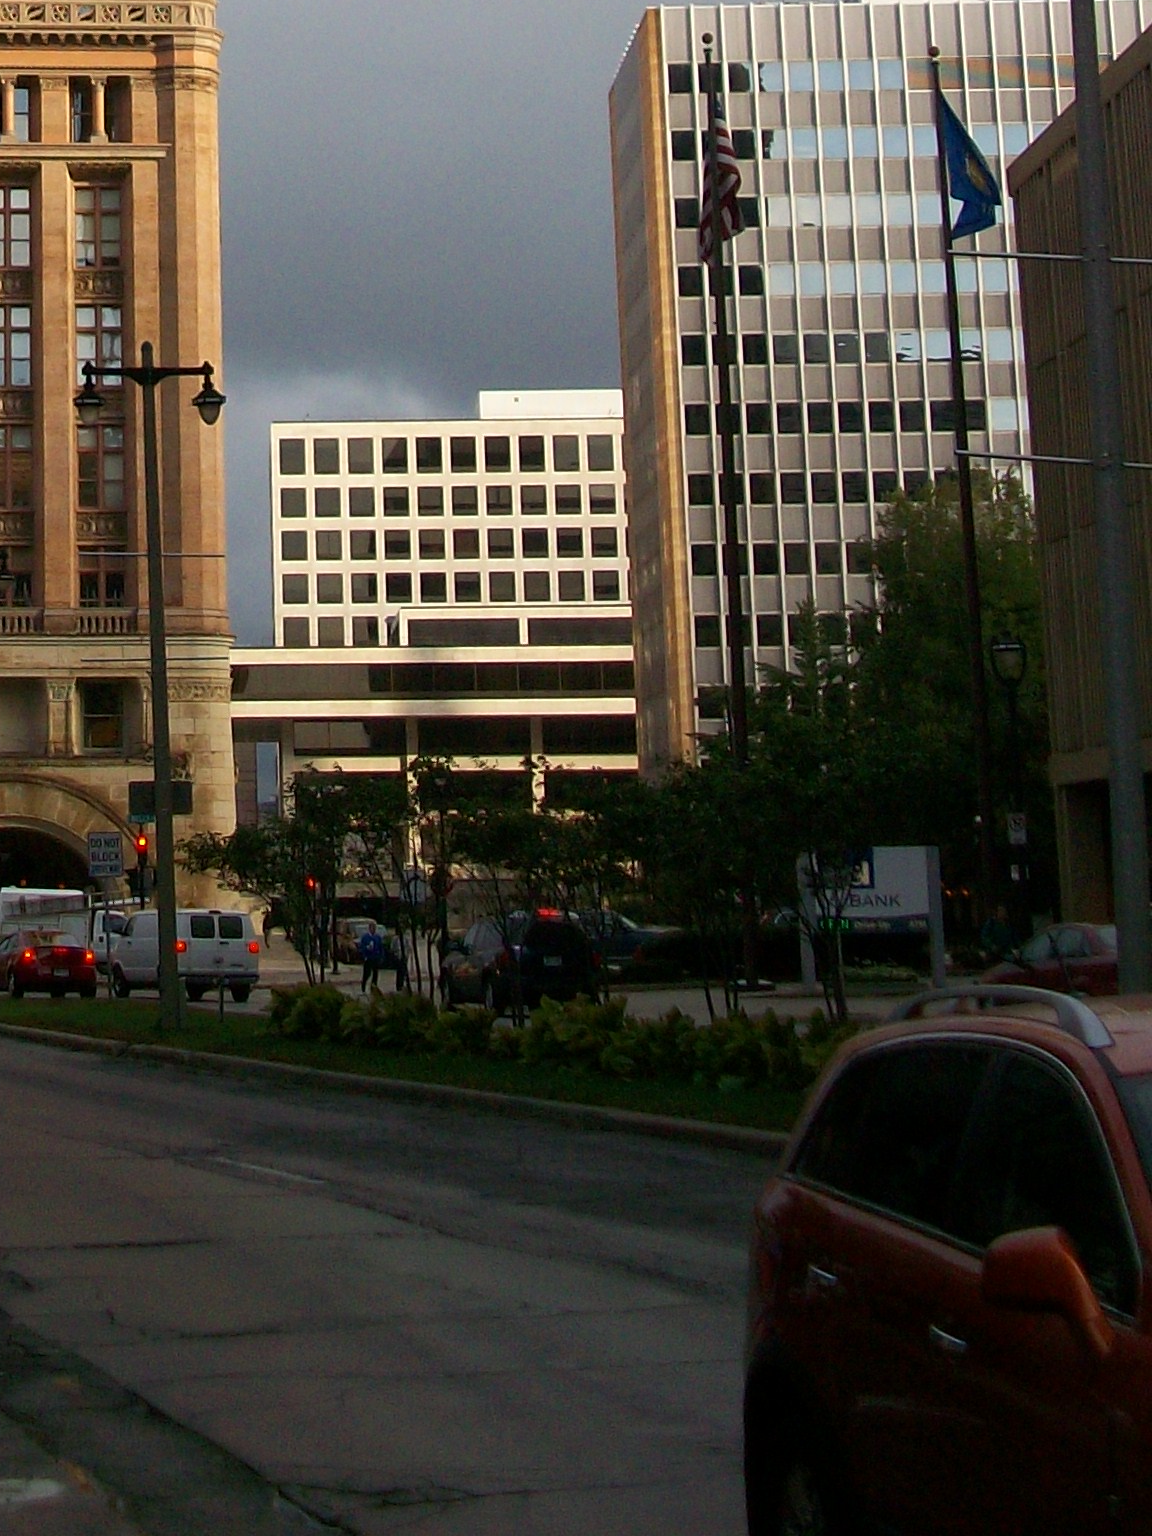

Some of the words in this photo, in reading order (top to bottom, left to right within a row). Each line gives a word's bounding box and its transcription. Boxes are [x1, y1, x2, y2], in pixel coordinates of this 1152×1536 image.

[91, 838, 102, 848] DO
[104, 838, 119, 848] NOT
[91, 852, 119, 862] BLOCK
[850, 893, 901, 907] BANK
